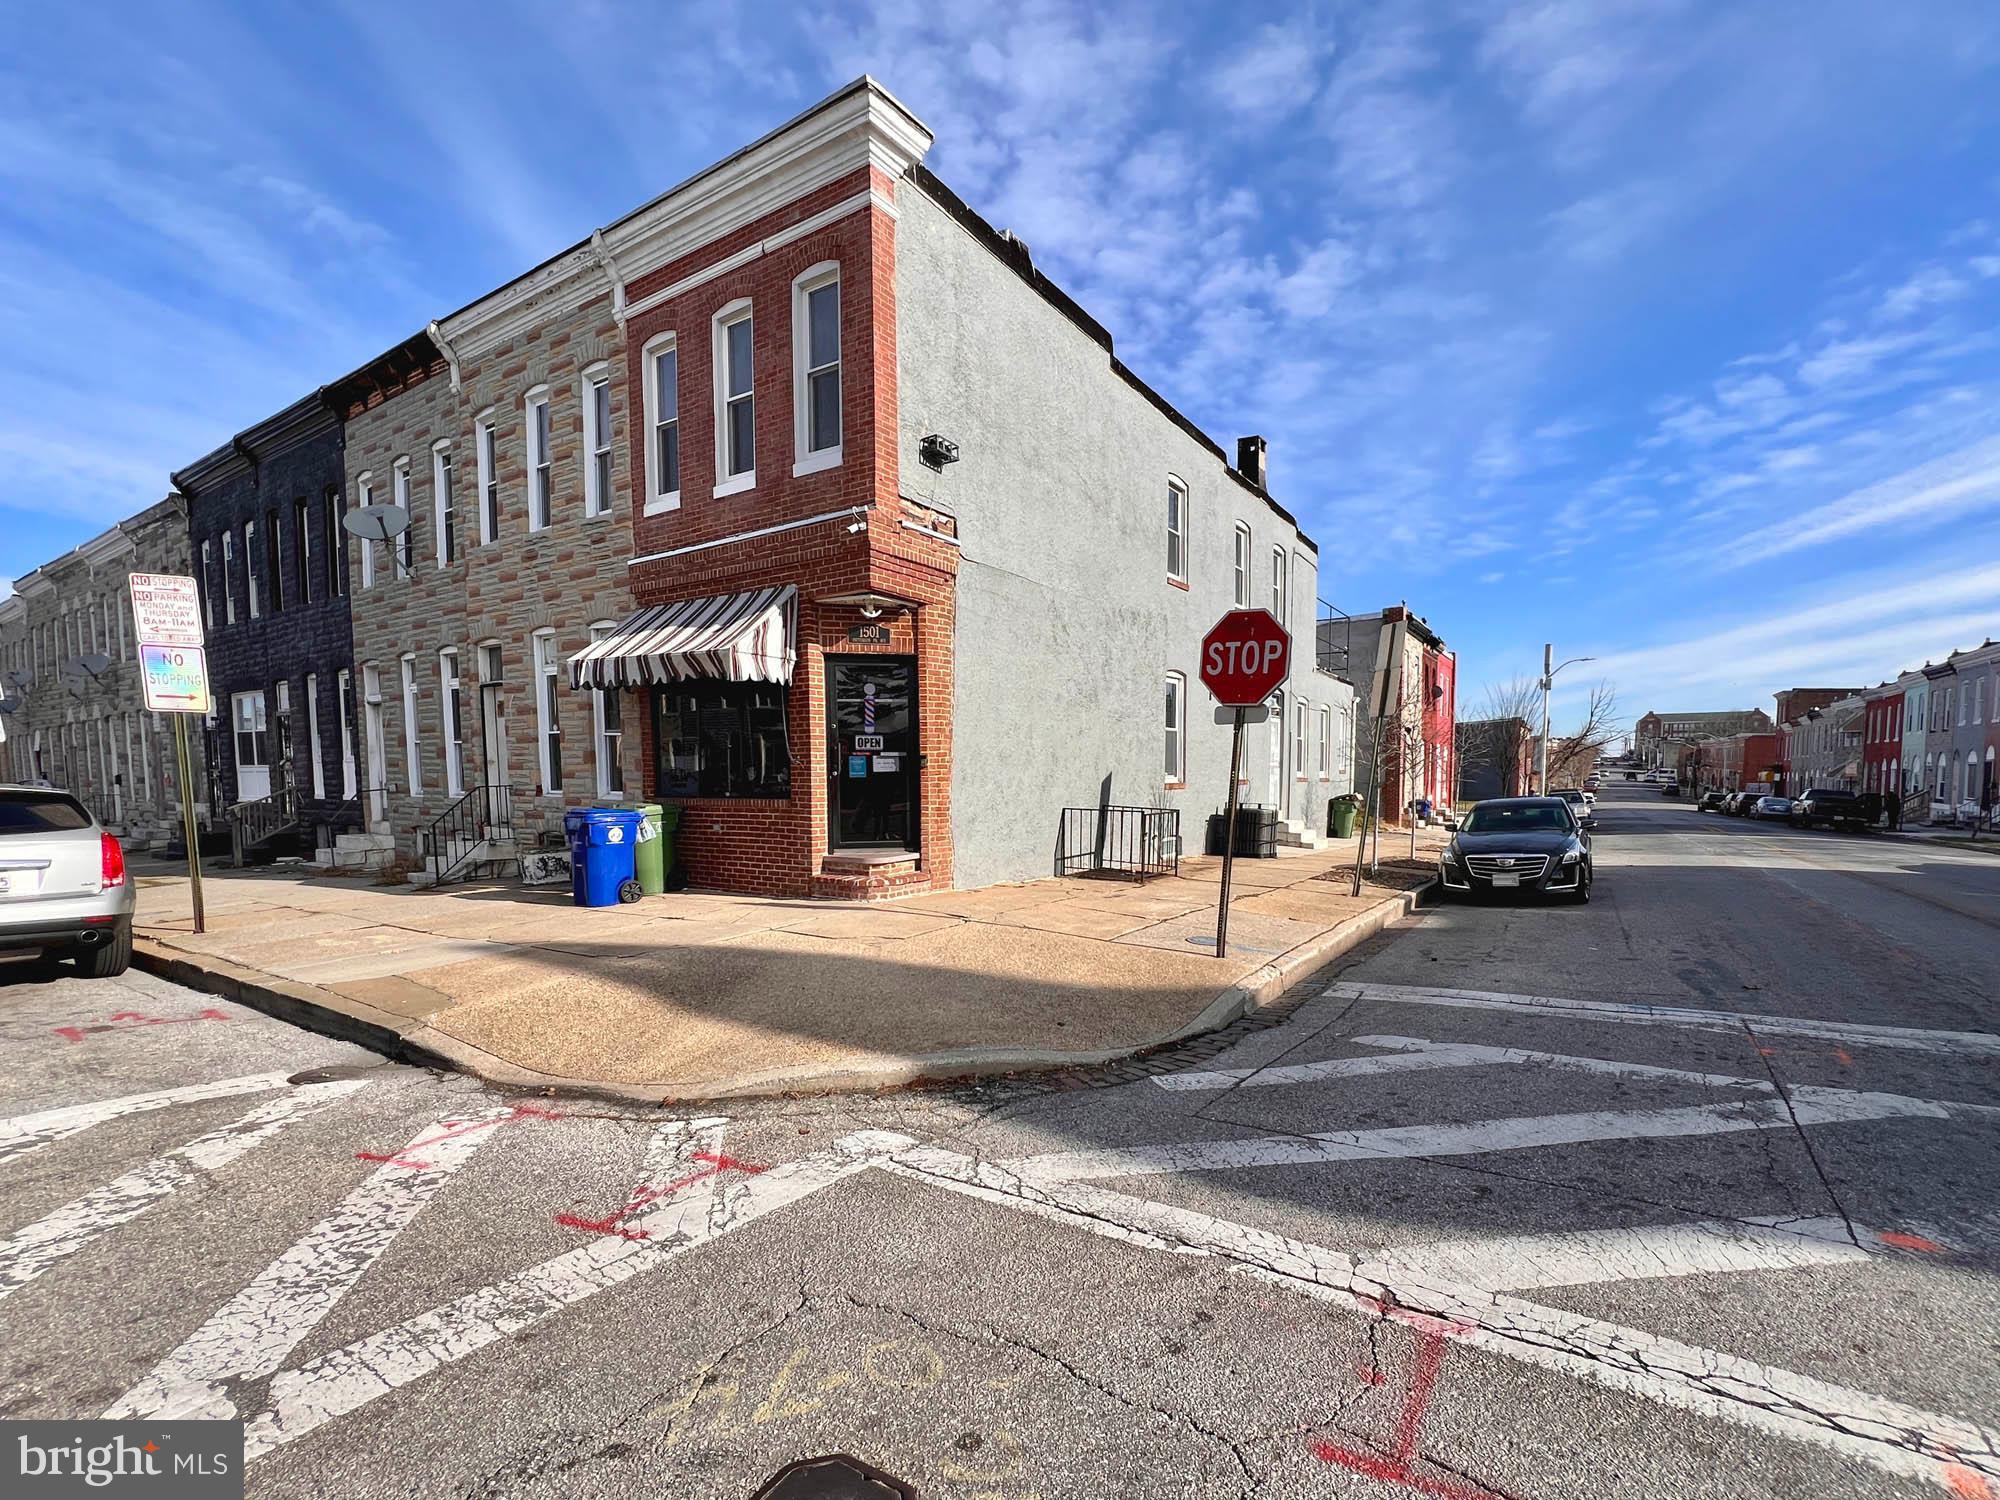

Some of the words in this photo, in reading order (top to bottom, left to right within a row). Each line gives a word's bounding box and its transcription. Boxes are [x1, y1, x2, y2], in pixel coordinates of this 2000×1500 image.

[133, 577, 149, 585] NO
[153, 578, 192, 588] STOPPING
[135, 592, 151, 600] NO
[154, 593, 194, 603] PARKING
[140, 601, 175, 610] MONDAY
[144, 609, 190, 617] THURSDAY
[143, 617, 195, 626] 8AM-11AM
[859, 626, 880, 638] 1501
[162, 653, 184, 667] NO
[1206, 640, 1283, 676] STOP
[149, 672, 202, 686] STOPPING
[858, 737, 881, 748] OPEN
